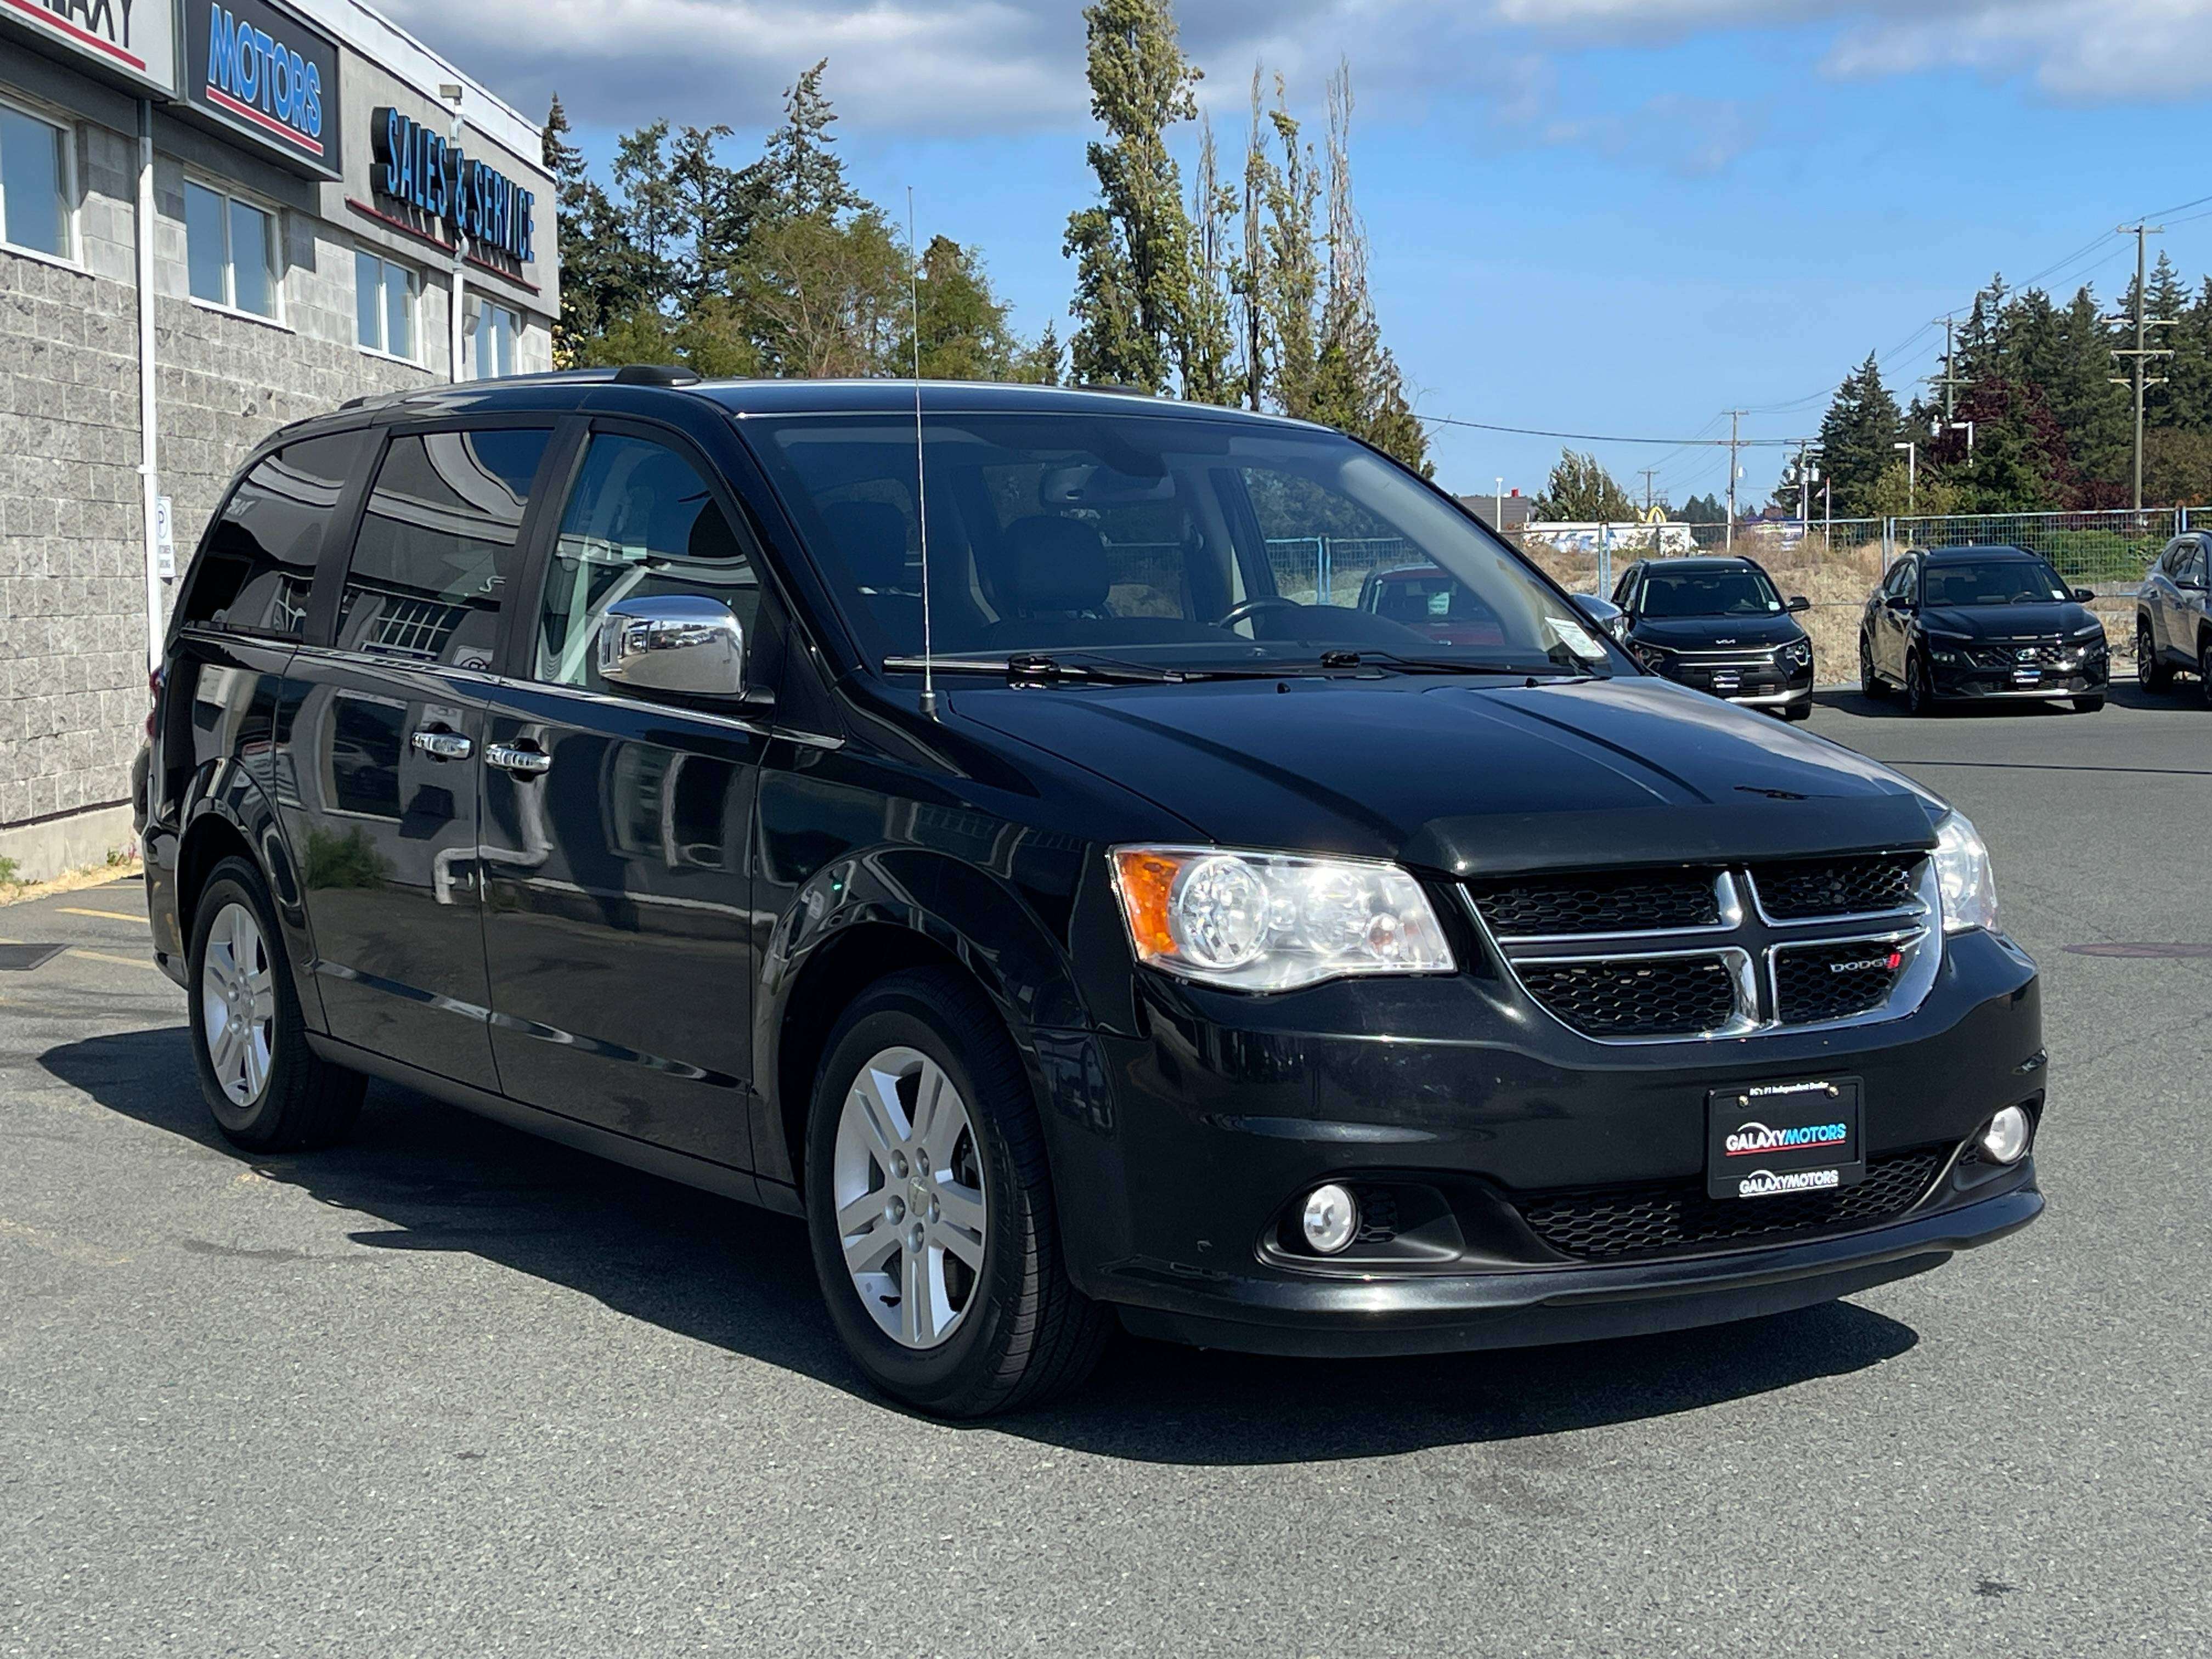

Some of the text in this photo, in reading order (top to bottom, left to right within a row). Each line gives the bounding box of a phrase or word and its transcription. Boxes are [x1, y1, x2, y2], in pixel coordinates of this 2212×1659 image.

[208, 2, 323, 138] MOTORS
[386, 106, 535, 263] SALES & SERVICE
